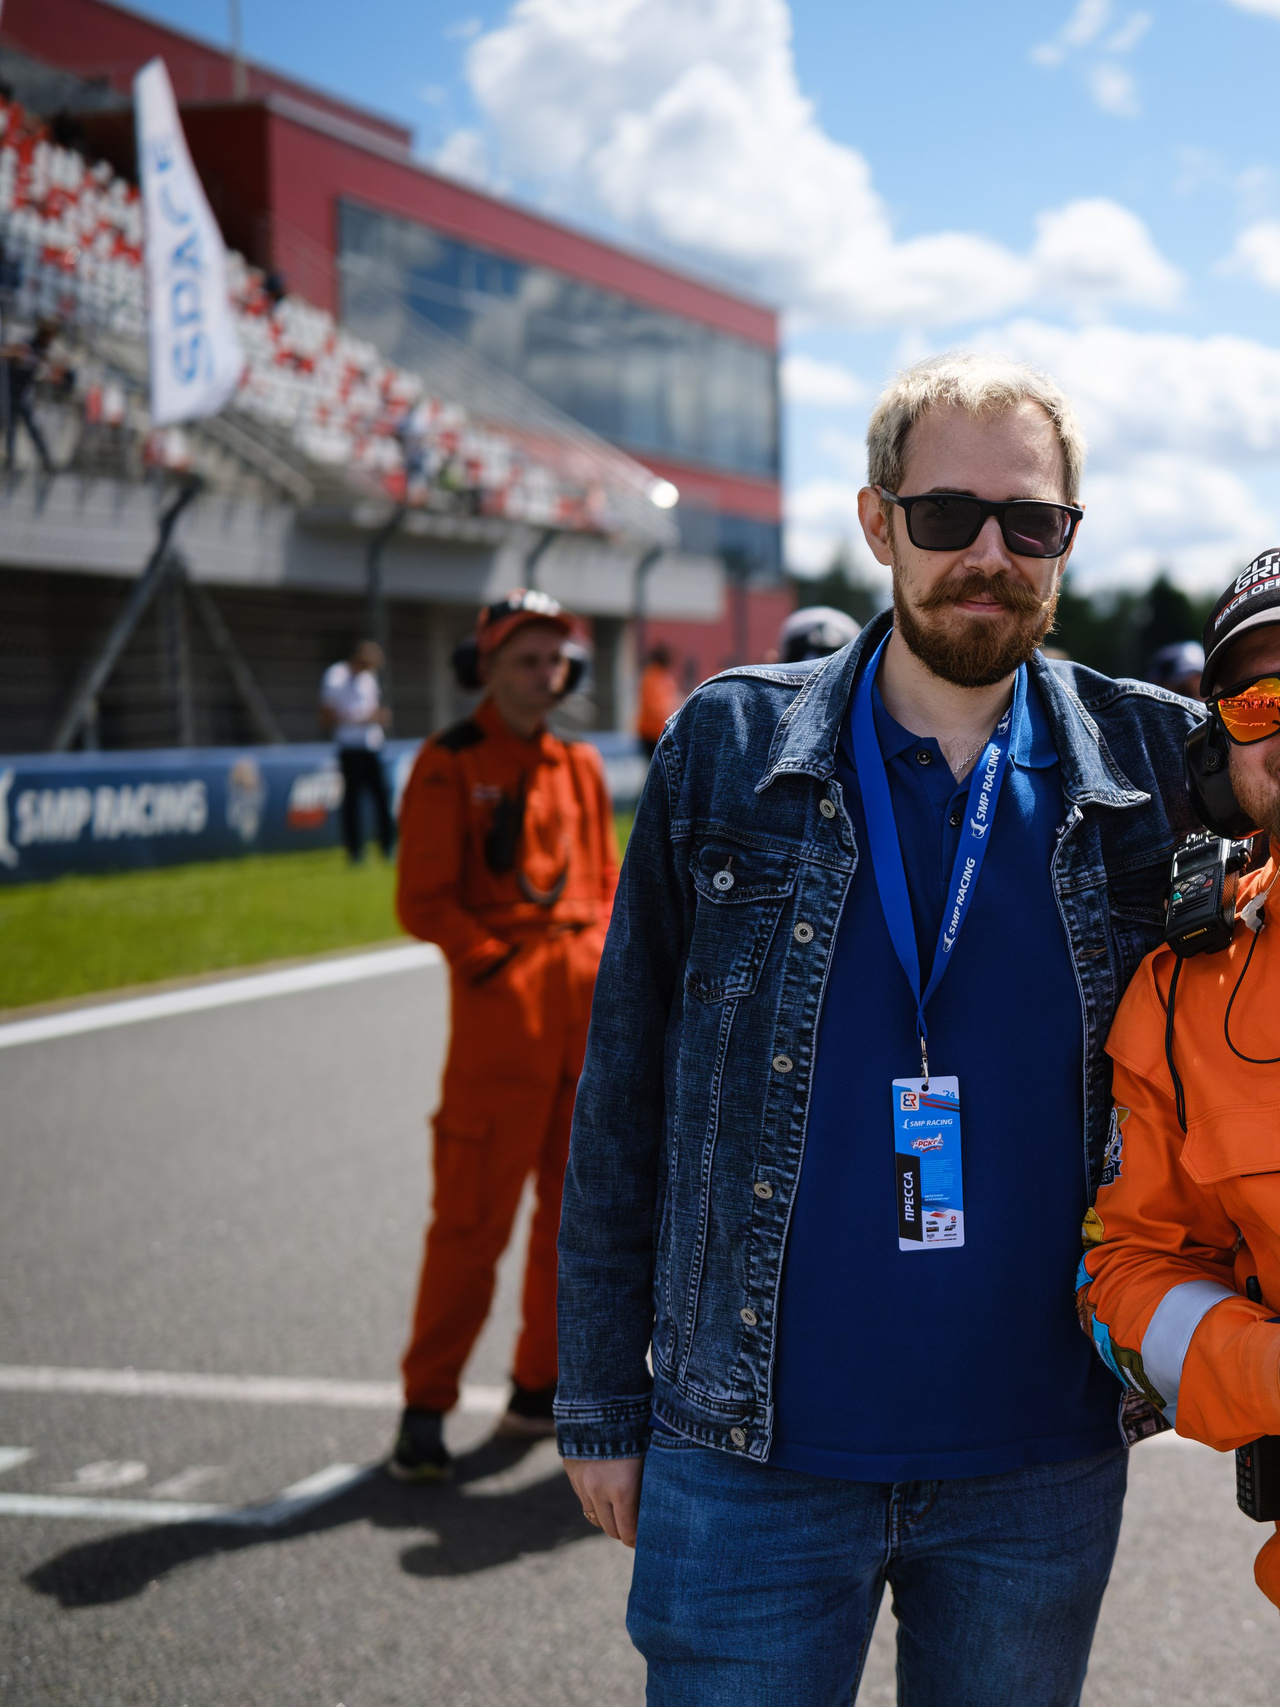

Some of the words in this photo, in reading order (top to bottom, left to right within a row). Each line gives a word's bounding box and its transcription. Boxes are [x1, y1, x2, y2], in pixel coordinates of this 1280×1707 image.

[1236, 552, 1280, 585] PIT
[1214, 591, 1248, 632] RACE
[982, 748, 1001, 792] RACING
[15, 788, 91, 846] SMP
[93, 779, 208, 840] RACING
[976, 792, 990, 822] SMP
[948, 906, 961, 935] SMP
[956, 857, 976, 906] RACING
[926, 1118, 953, 1126] RACING
[903, 1171, 915, 1221] ПРЕССА
